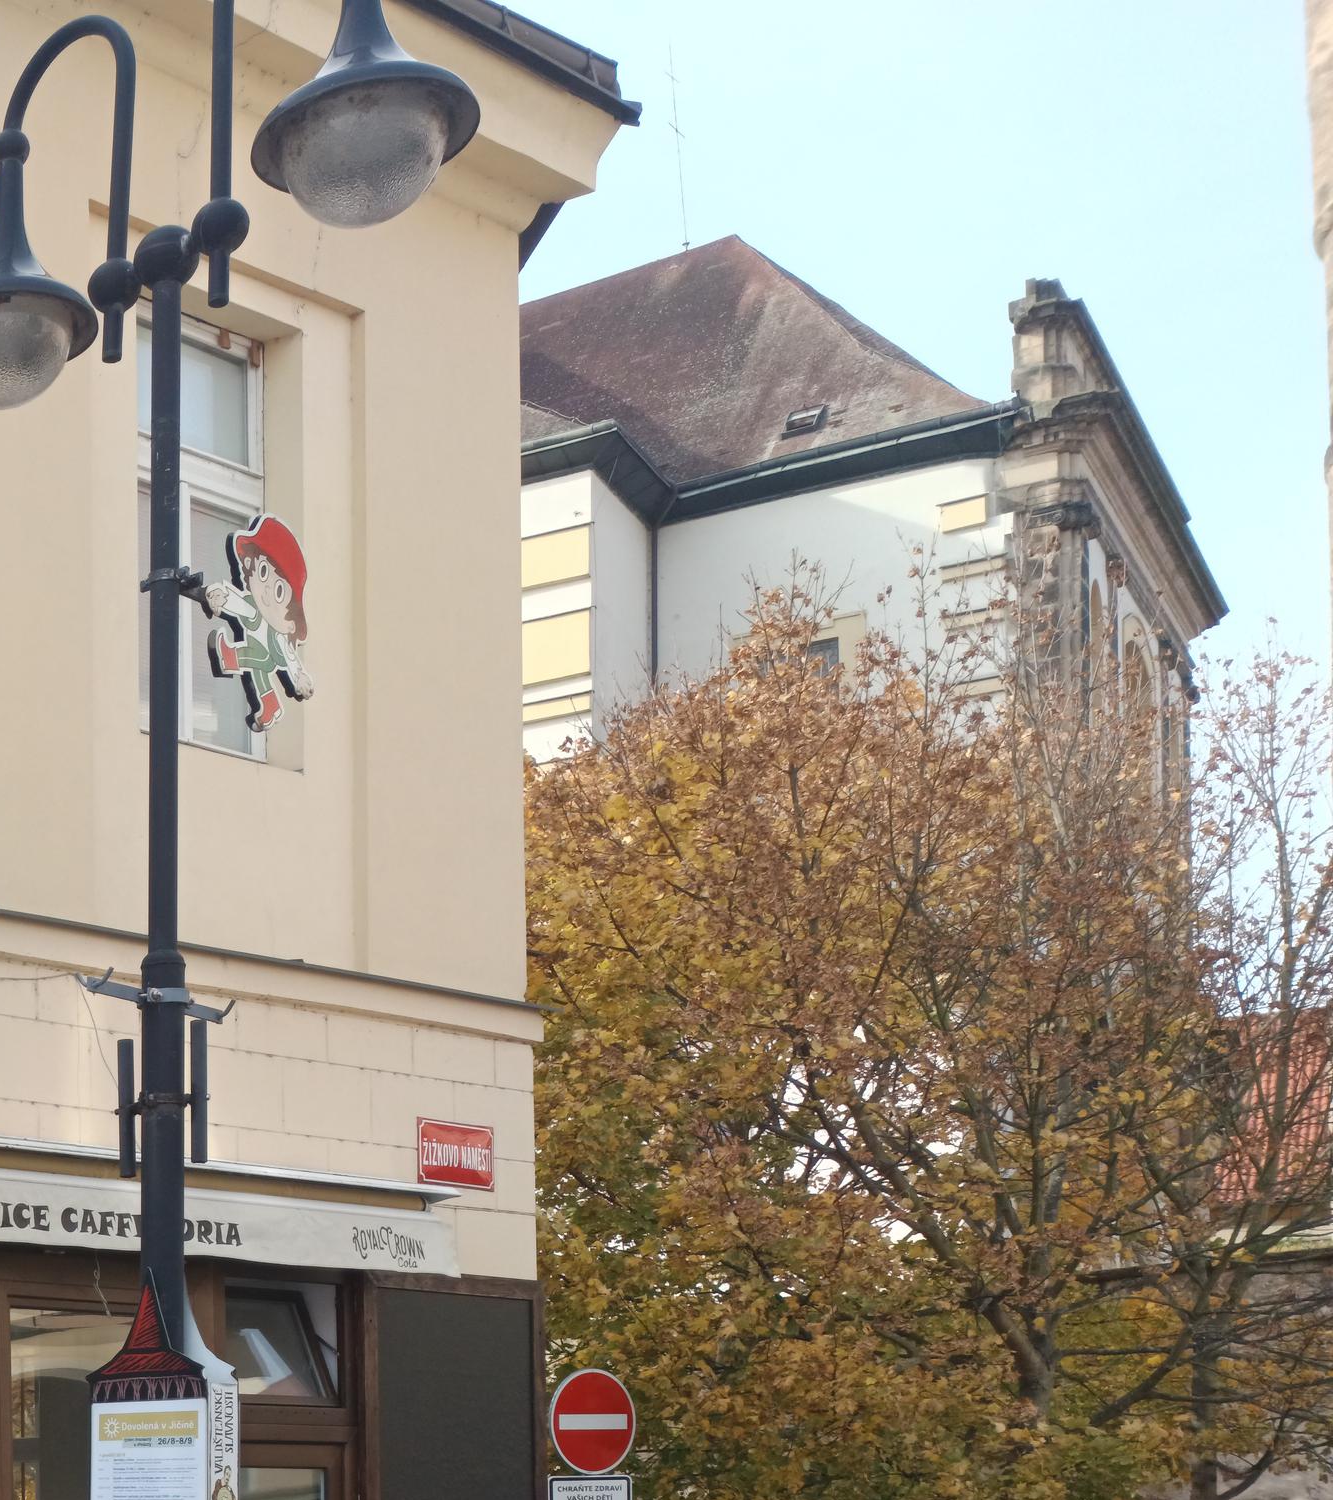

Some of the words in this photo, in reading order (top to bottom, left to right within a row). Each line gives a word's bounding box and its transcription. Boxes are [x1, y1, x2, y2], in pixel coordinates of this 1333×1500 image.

[422, 1138, 459, 1168] ŽIŽKOVO
[461, 1143, 492, 1172] NÁMĚSTÍ
[0, 1202, 50, 1231] ICE
[398, 1257, 417, 1268] Cola
[557, 1484, 593, 1492] CHRAŇTE
[595, 1484, 622, 1492] ZDRAVÍ
[567, 1493, 594, 1500] VAŠICH
[596, 1493, 613, 1500] DĚTÍ
